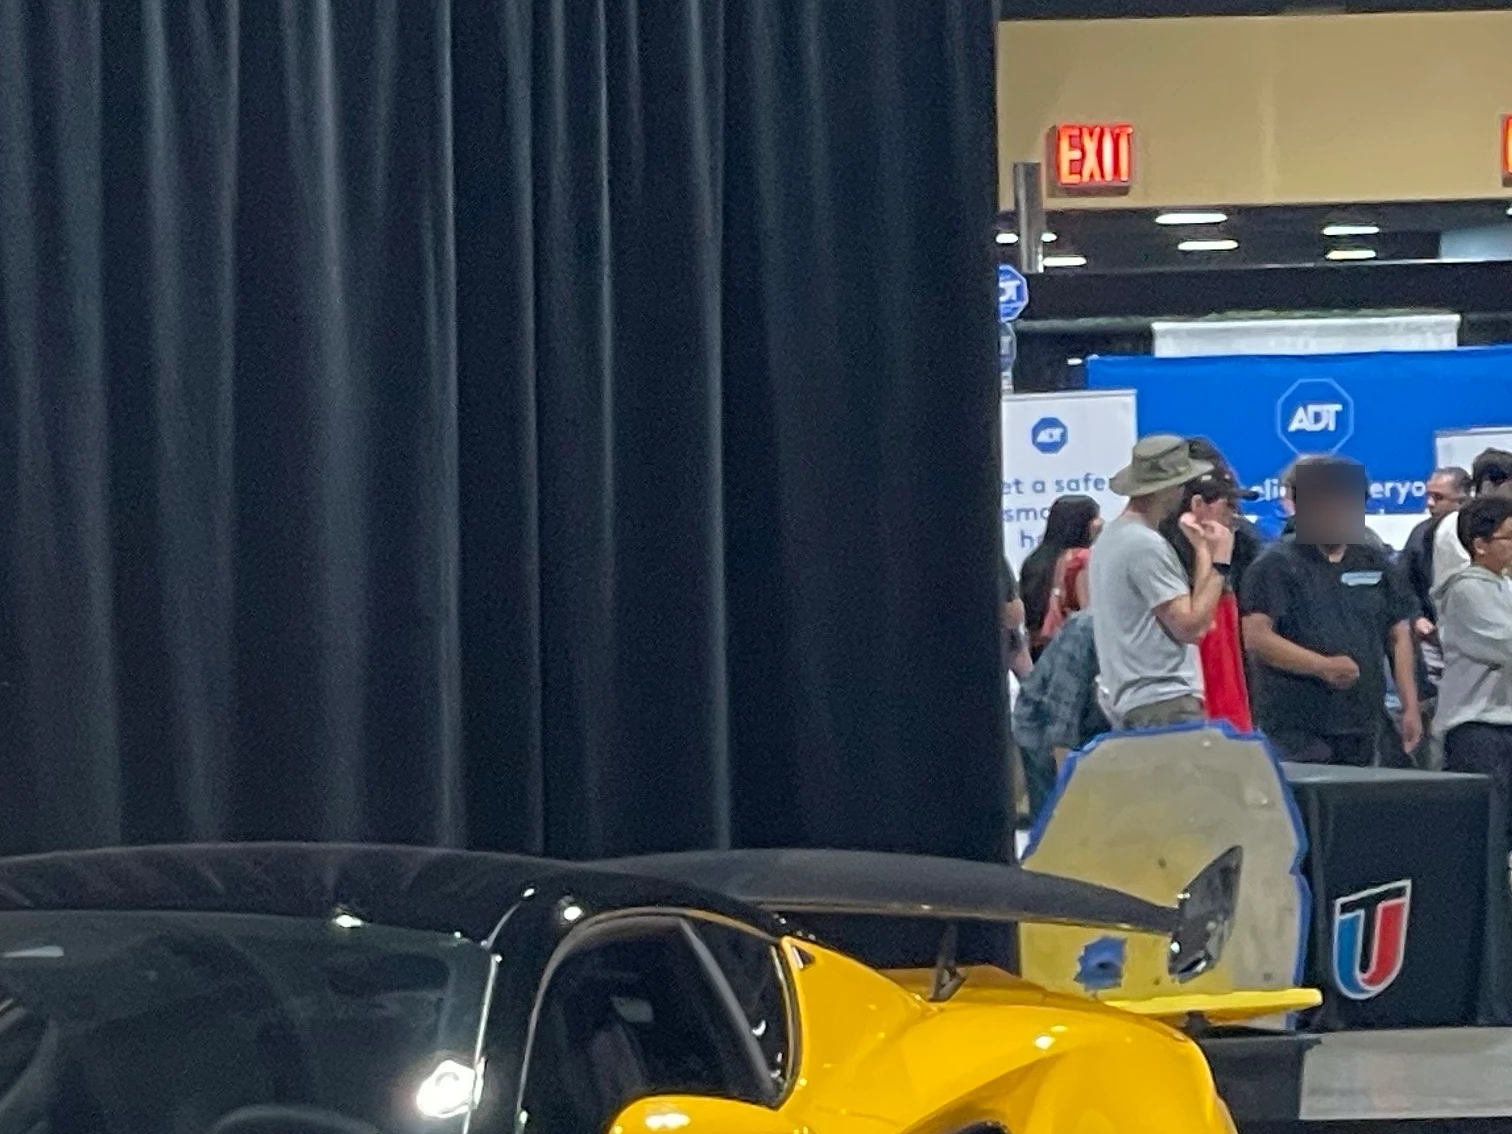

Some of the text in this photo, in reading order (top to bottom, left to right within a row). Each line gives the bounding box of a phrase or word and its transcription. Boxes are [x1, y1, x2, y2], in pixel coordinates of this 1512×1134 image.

[1059, 126, 1133, 184] EXIT
[1288, 404, 1343, 432] ADT
[1000, 478, 1024, 495] et
[1031, 480, 1046, 494] a
